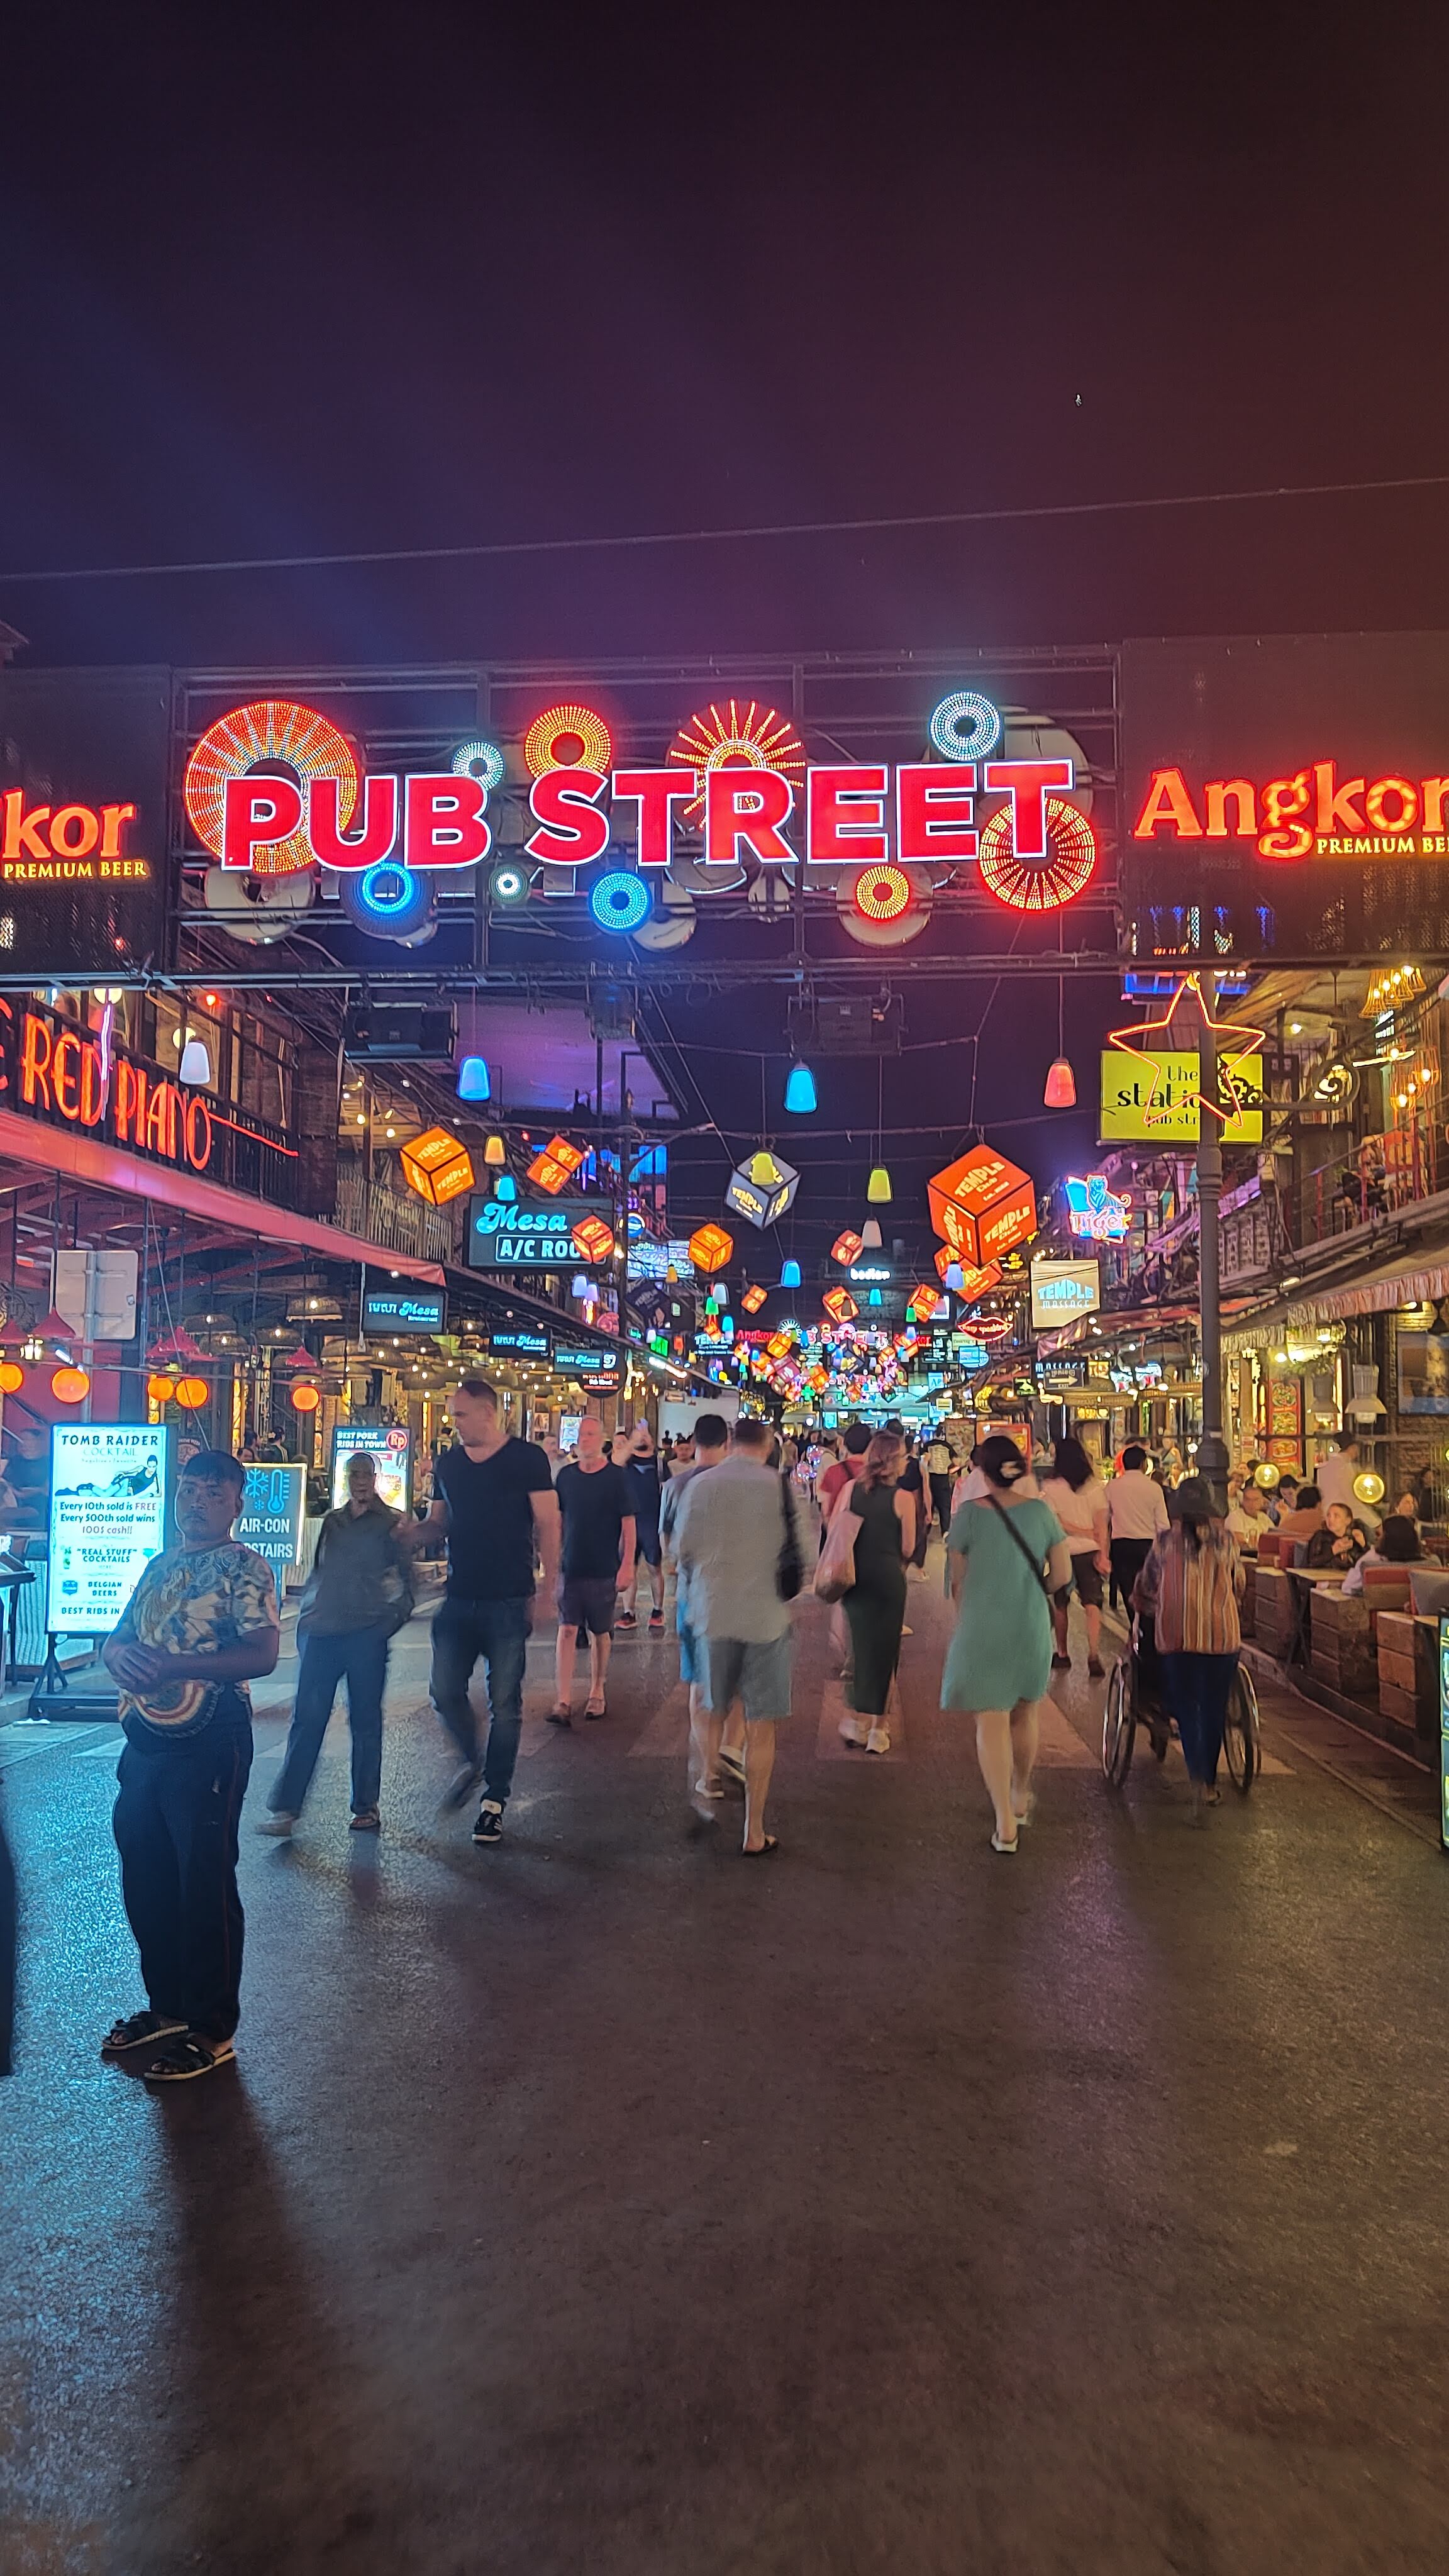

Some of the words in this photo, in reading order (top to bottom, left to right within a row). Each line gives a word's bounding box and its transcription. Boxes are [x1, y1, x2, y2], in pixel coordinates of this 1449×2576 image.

[0, 787, 136, 860] kor
[221, 773, 493, 872] PUB
[523, 757, 1074, 868] STREET
[1317, 836, 1416, 855] PREMIUM
[1422, 836, 1449, 854] BE
[4, 862, 93, 879] PREMIUM
[99, 860, 147, 877] BEER
[1167, 1065, 1198, 1082] the
[21, 1011, 103, 1127] RED
[114, 1059, 212, 1171] PIANO
[1177, 1113, 1201, 1125] str
[954, 1161, 1006, 1198] TEMPLE
[475, 1202, 568, 1235] Mesa
[984, 1206, 1031, 1244] TEMPLE
[1072, 1211, 1133, 1240] Tiger
[500, 1239, 536, 1260] A/C
[541, 1240, 580, 1258] ROO
[1038, 1279, 1094, 1299] TEMPLE
[399, 1302, 439, 1316] Mesa
[1041, 1300, 1090, 1309] MASSAGE
[516, 1335, 547, 1346] Mesa
[62, 1435, 100, 1445] TOMB
[106, 1435, 158, 1445] RAIDER
[83, 1448, 138, 1456] COCKTAIL
[60, 1502, 83, 1512] Every
[85, 1502, 104, 1510] 10th
[106, 1502, 125, 1510] sold
[126, 1502, 133, 1510] is
[60, 1513, 83, 1523] Every
[86, 1513, 114, 1522] 500th
[116, 1513, 135, 1522] sold
[136, 1513, 155, 1522] wins
[240, 1518, 290, 1533] AIR-CON
[82, 1525, 104, 1534] 100$
